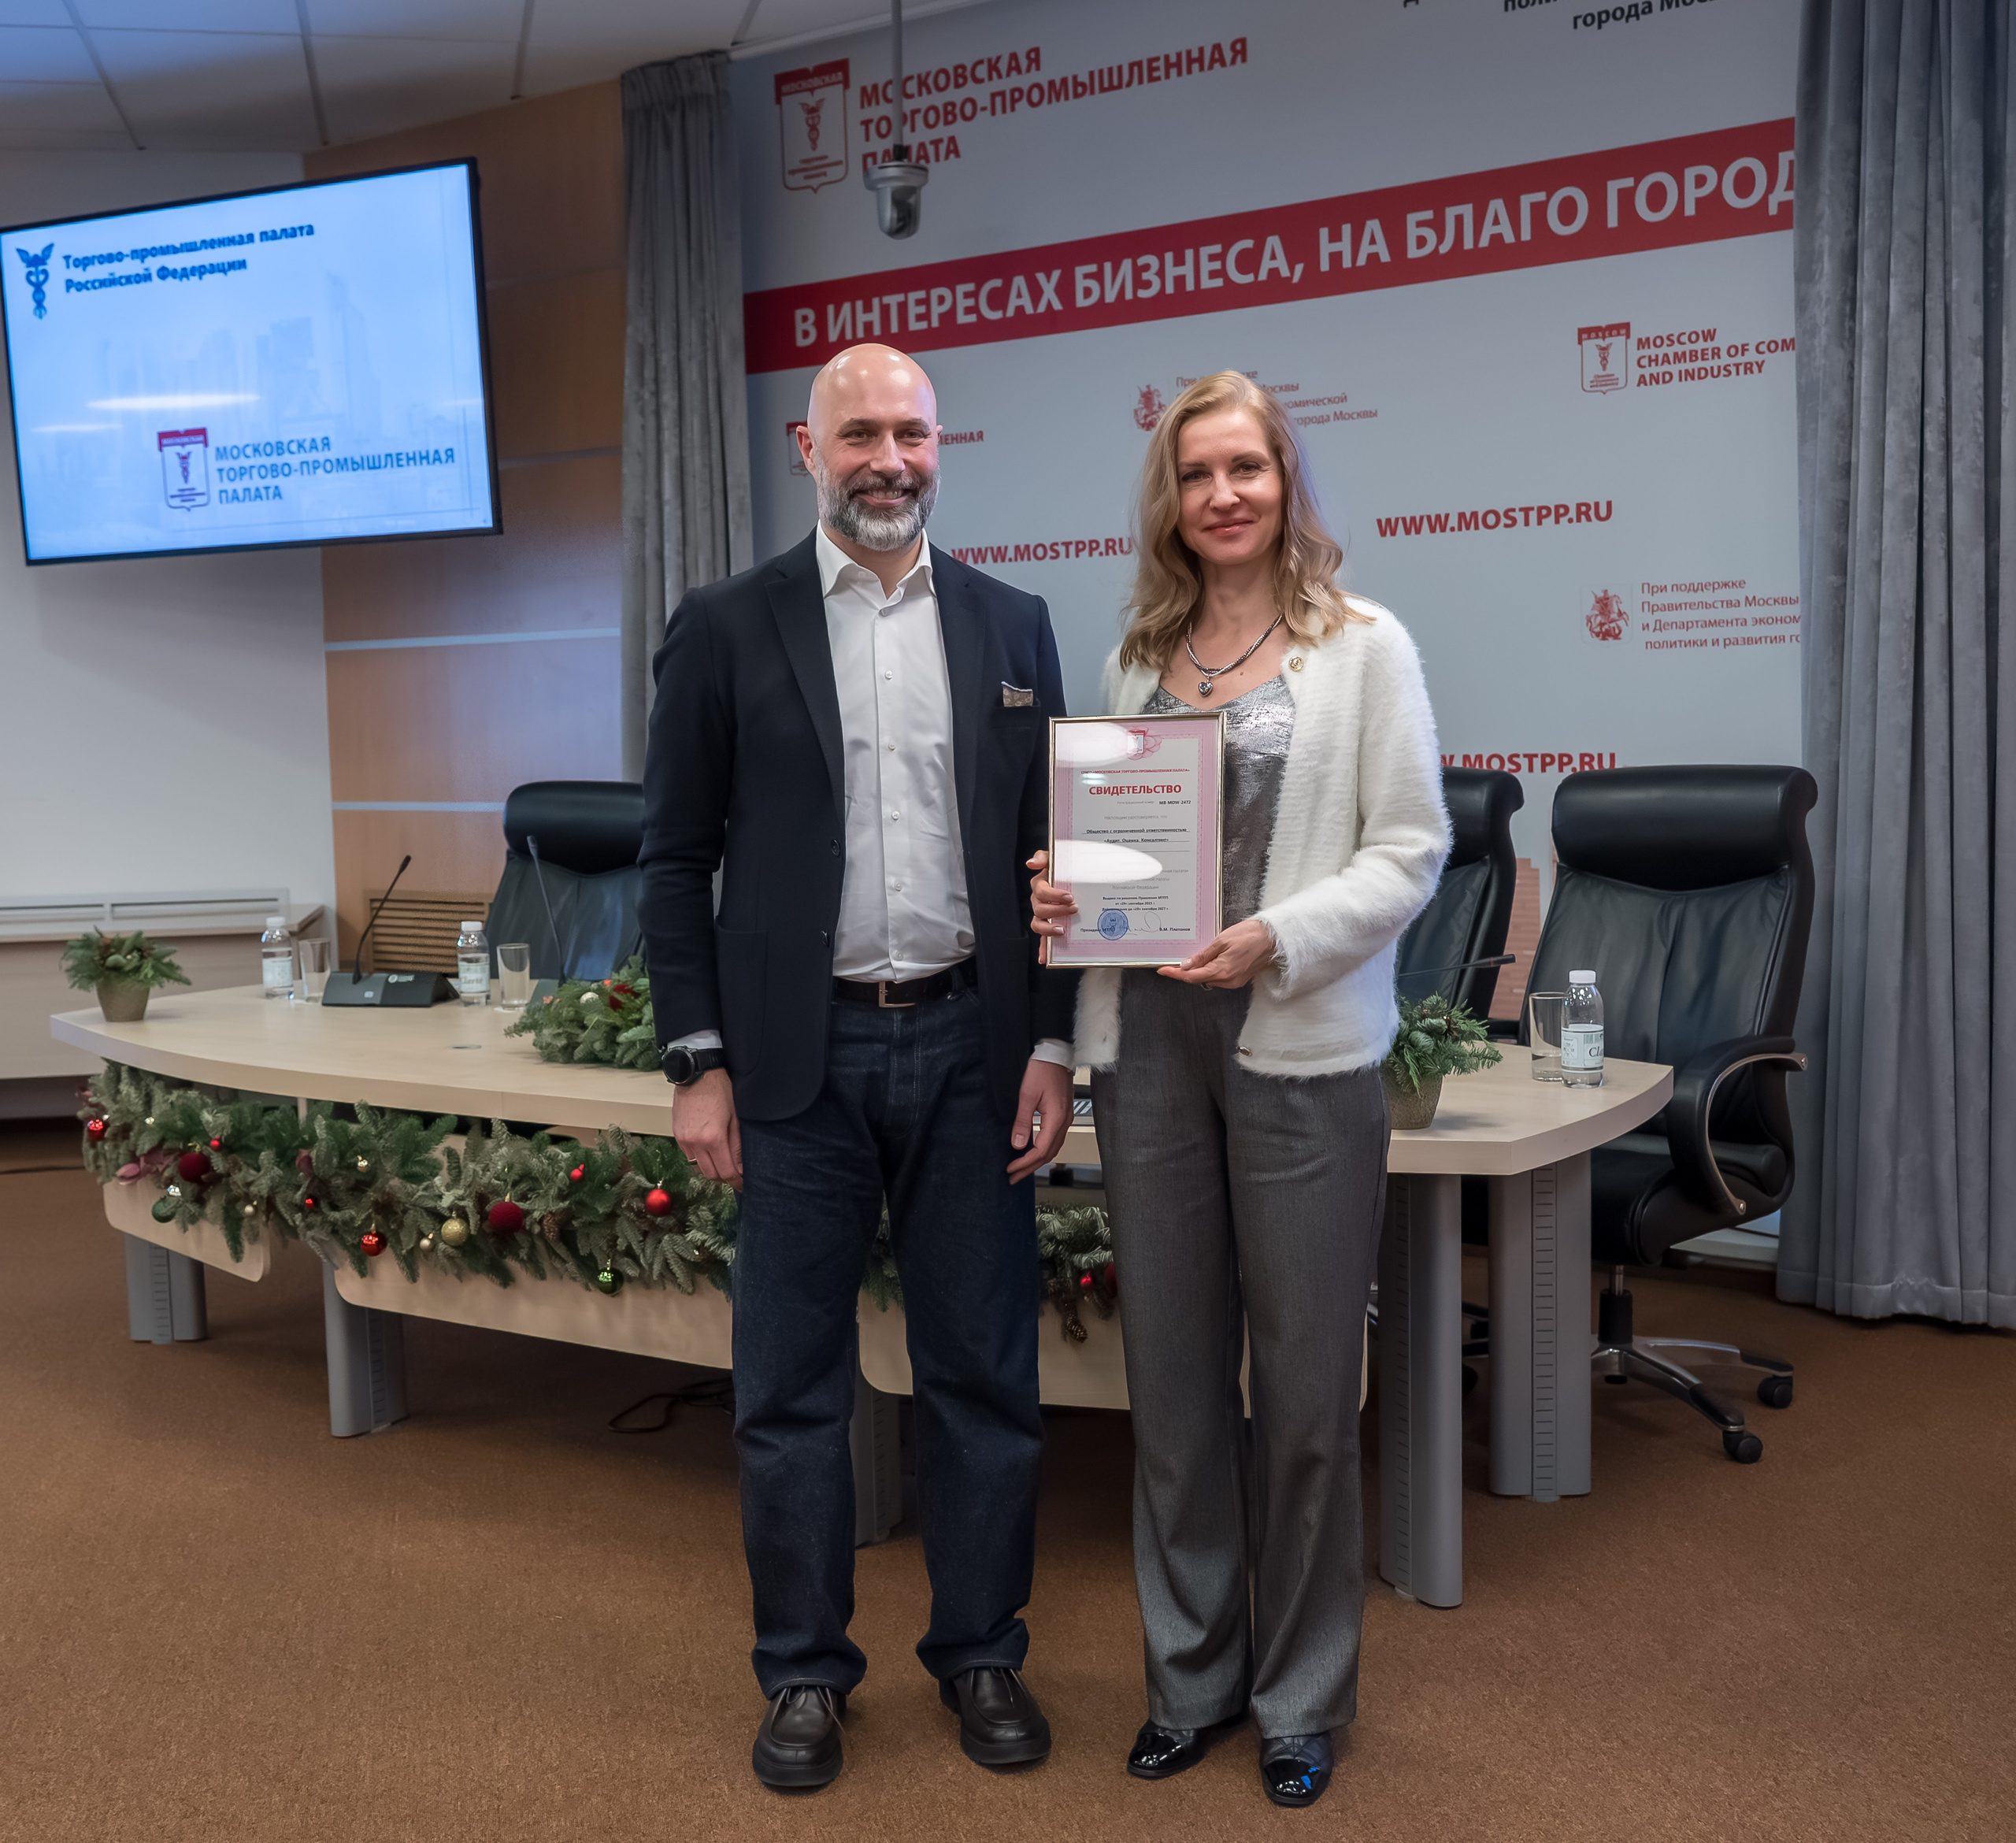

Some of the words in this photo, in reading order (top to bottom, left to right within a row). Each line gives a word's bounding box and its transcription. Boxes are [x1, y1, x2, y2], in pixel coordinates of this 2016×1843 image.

[1573, 0, 1653, 30] города
[860, 37, 1248, 143] ТОГОВО-ПРОМЫШЛЕННАЯ
[62, 232, 255, 272] Торгово-промышленная
[259, 224, 314, 243] палата
[65, 268, 153, 293] Российской
[156, 258, 247, 282] Федерации
[794, 308, 817, 347] В
[826, 269, 1063, 343] ИНТЕРЕСАХ
[1074, 235, 1305, 308] БИЗНЕСА,
[1319, 218, 1391, 272] НА
[1406, 185, 1589, 259] БЛАГО
[1636, 328, 1718, 350] MOSCOW
[1636, 347, 1721, 369] CHAMBER
[1726, 343, 1750, 358] OF
[1636, 370, 1673, 387] AND
[1678, 360, 1766, 383] INDUSTRY
[1332, 410, 1378, 422] Москвы
[215, 436, 332, 462] МОСКОВСКАЯ
[217, 447, 456, 483] ТОРГОВО-ПРОМЫШЛЕННАЯ
[218, 485, 284, 505] ПАЛАТА
[1376, 500, 1613, 538] WWW.MOSTPP.RU
[1641, 582, 1667, 596] При
[1671, 580, 1746, 593] поддержке
[1641, 599, 1740, 615] Правительства
[1744, 595, 1799, 608] Москвы
[1642, 622, 1650, 632] и
[1652, 617, 1747, 633] Департамента
[1645, 638, 1708, 650] политики
[1711, 638, 1720, 647] и
[1723, 634, 1786, 649] развития
[1089, 784, 1182, 796] СВИДЕТЕЛЬСТВО
